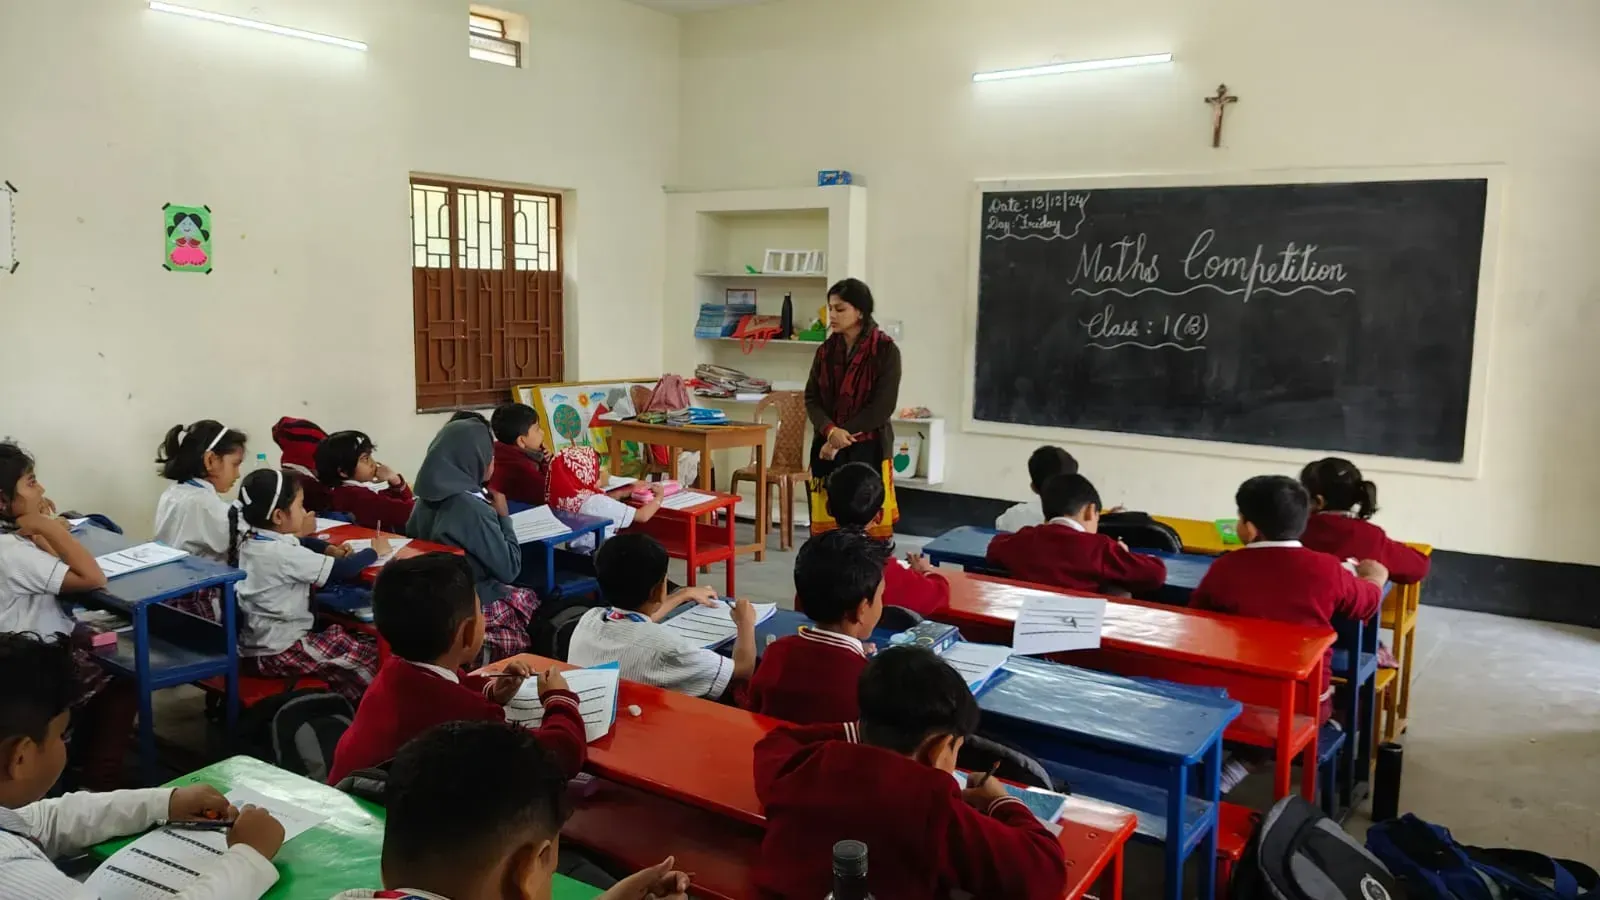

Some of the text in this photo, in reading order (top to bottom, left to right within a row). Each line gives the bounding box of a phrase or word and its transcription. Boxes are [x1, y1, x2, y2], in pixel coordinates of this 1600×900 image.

[1015, 213, 1061, 236] Friday
[1066, 228, 1348, 303] Maths Competition
